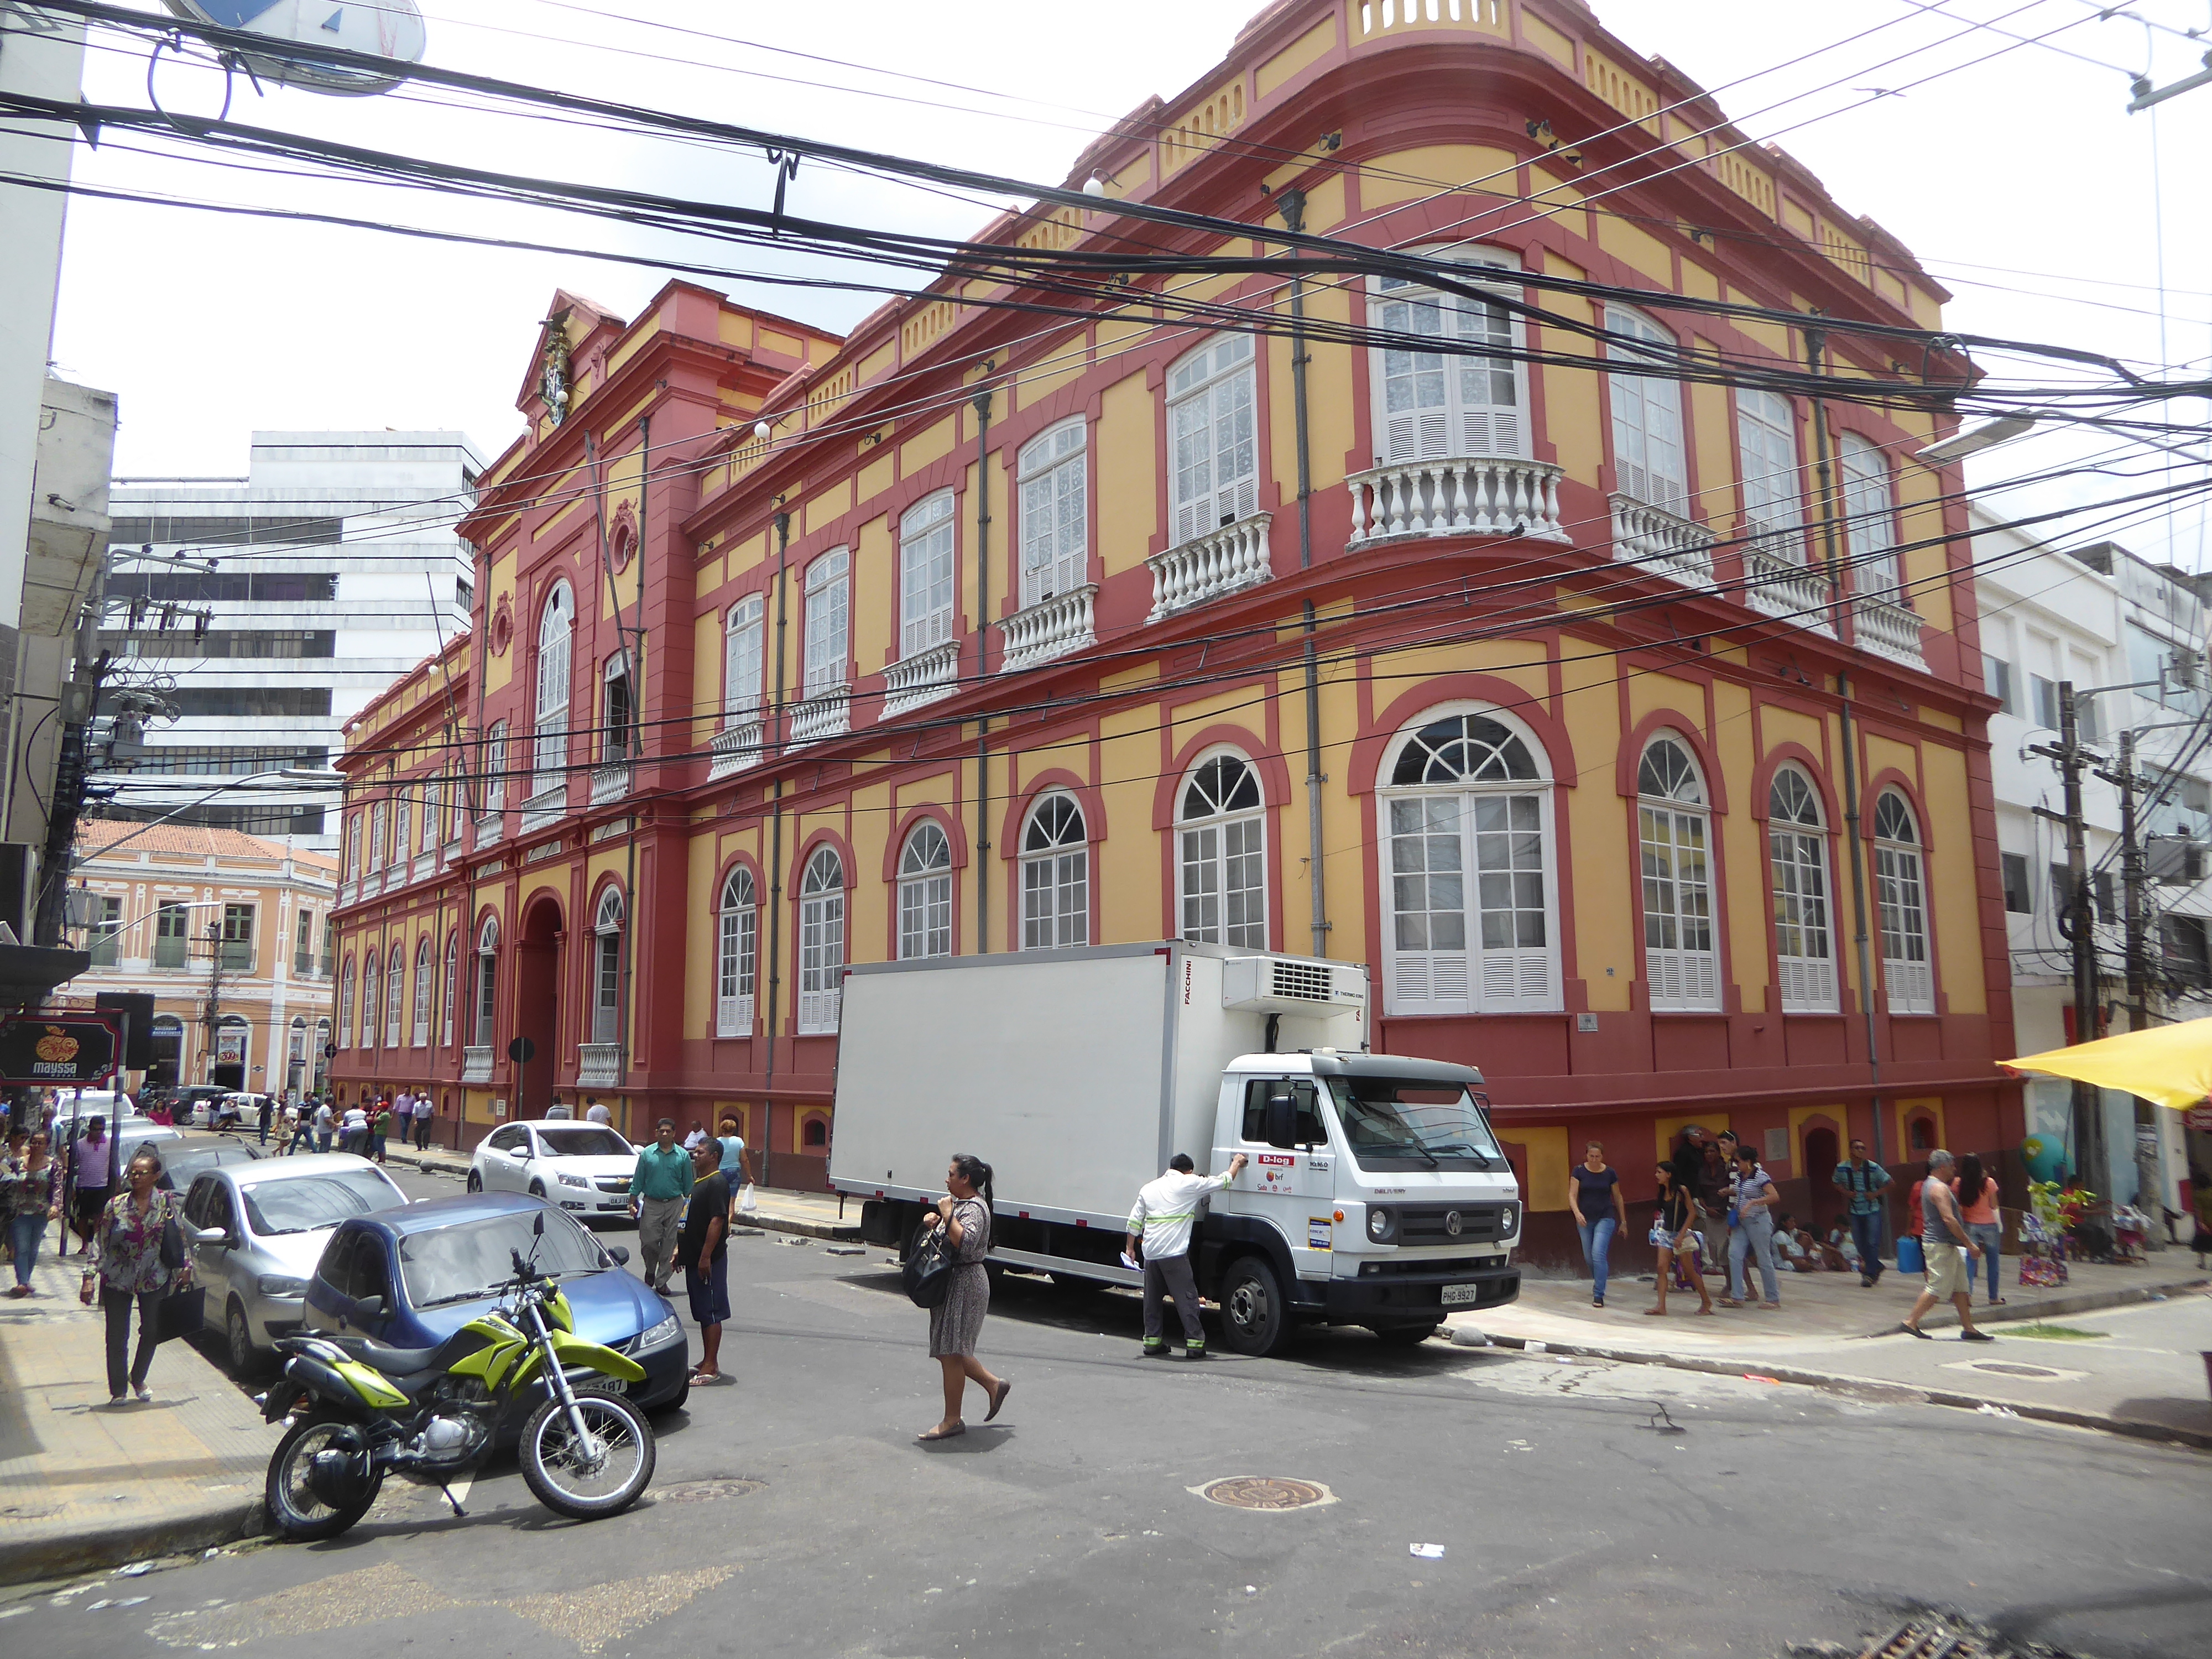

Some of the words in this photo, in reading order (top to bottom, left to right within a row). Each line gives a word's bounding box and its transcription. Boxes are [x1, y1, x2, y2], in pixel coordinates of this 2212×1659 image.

[33, 1062, 77, 1074] mayssa
[1262, 1155, 1290, 1165] D-log
[1275, 1173, 1284, 1181] brf
